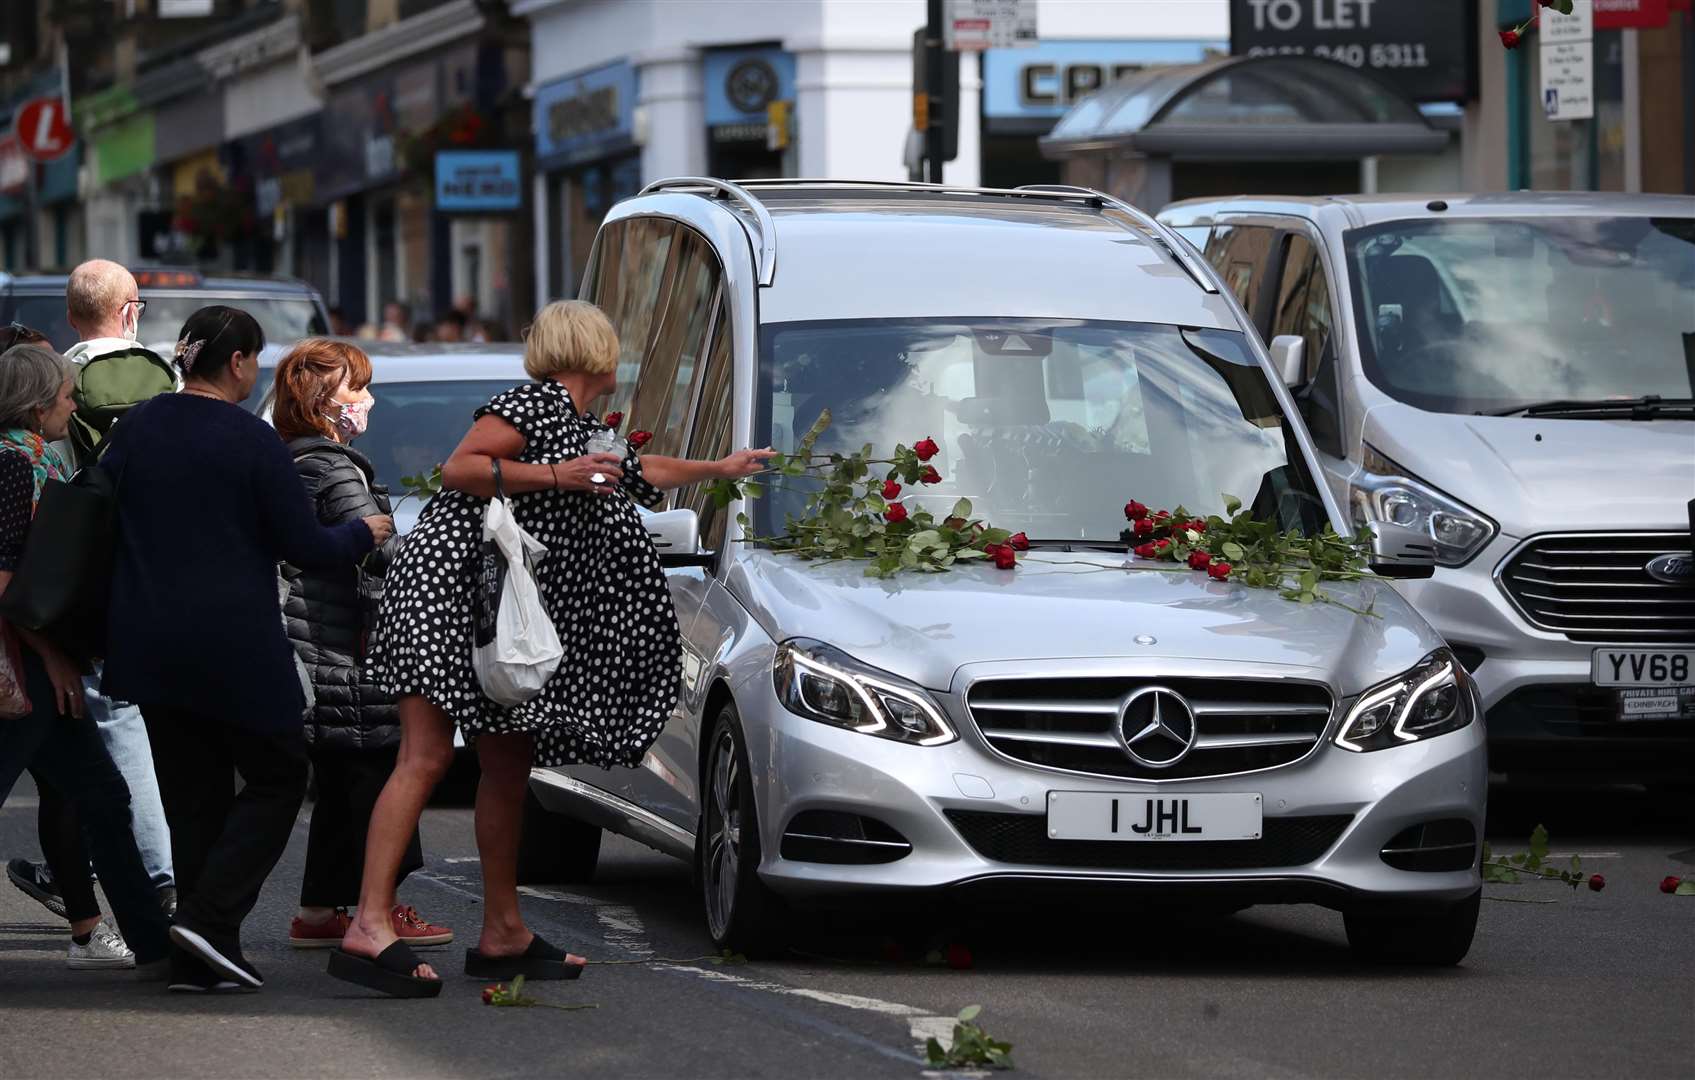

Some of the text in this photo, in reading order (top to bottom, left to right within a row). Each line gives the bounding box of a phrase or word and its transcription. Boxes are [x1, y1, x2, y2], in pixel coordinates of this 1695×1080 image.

[1250, 0, 1377, 30] TO LET
[33, 104, 62, 151] L
[1608, 654, 1689, 682] YV68
[1131, 799, 1203, 834] JHL
